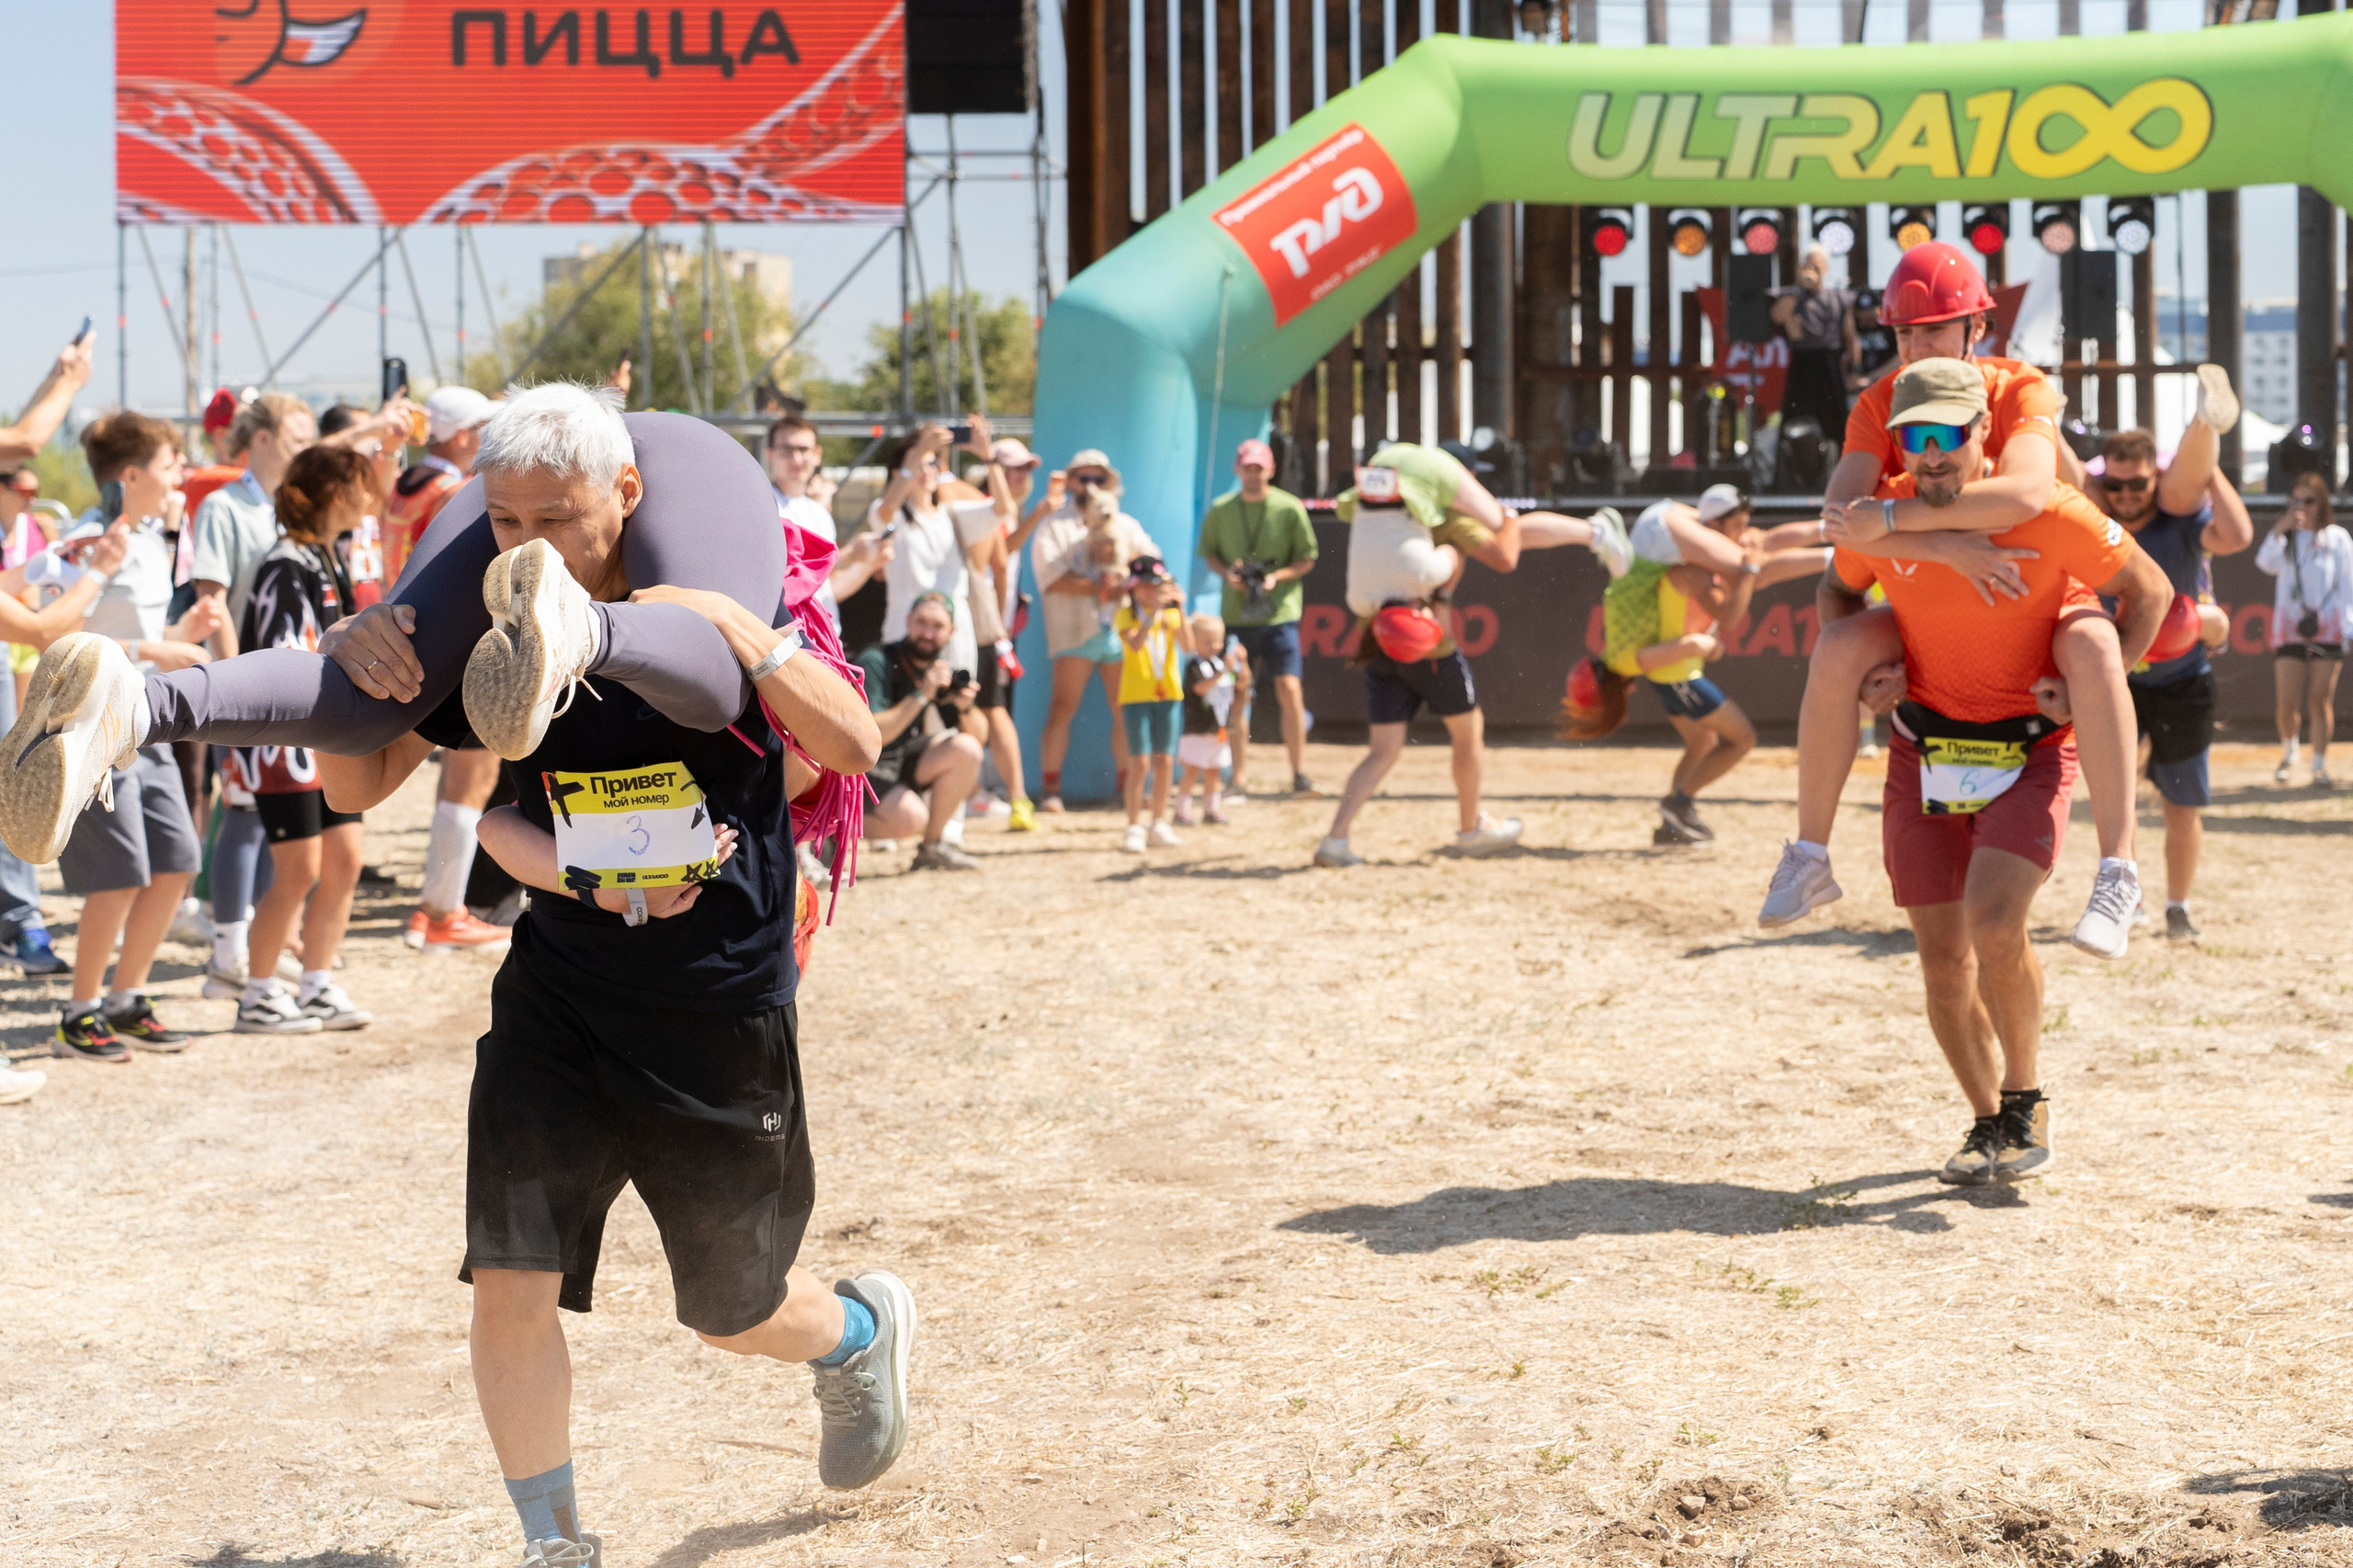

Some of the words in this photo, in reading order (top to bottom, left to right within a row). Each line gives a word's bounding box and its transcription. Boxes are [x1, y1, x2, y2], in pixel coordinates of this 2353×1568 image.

[450, 8, 801, 79] ПИЦЦА
[1947, 742, 1999, 757] Привет
[589, 771, 677, 799] Привет
[1960, 767, 1981, 797] 6
[603, 797, 629, 809] мой
[631, 792, 670, 806] номер
[626, 814, 651, 856] 3
